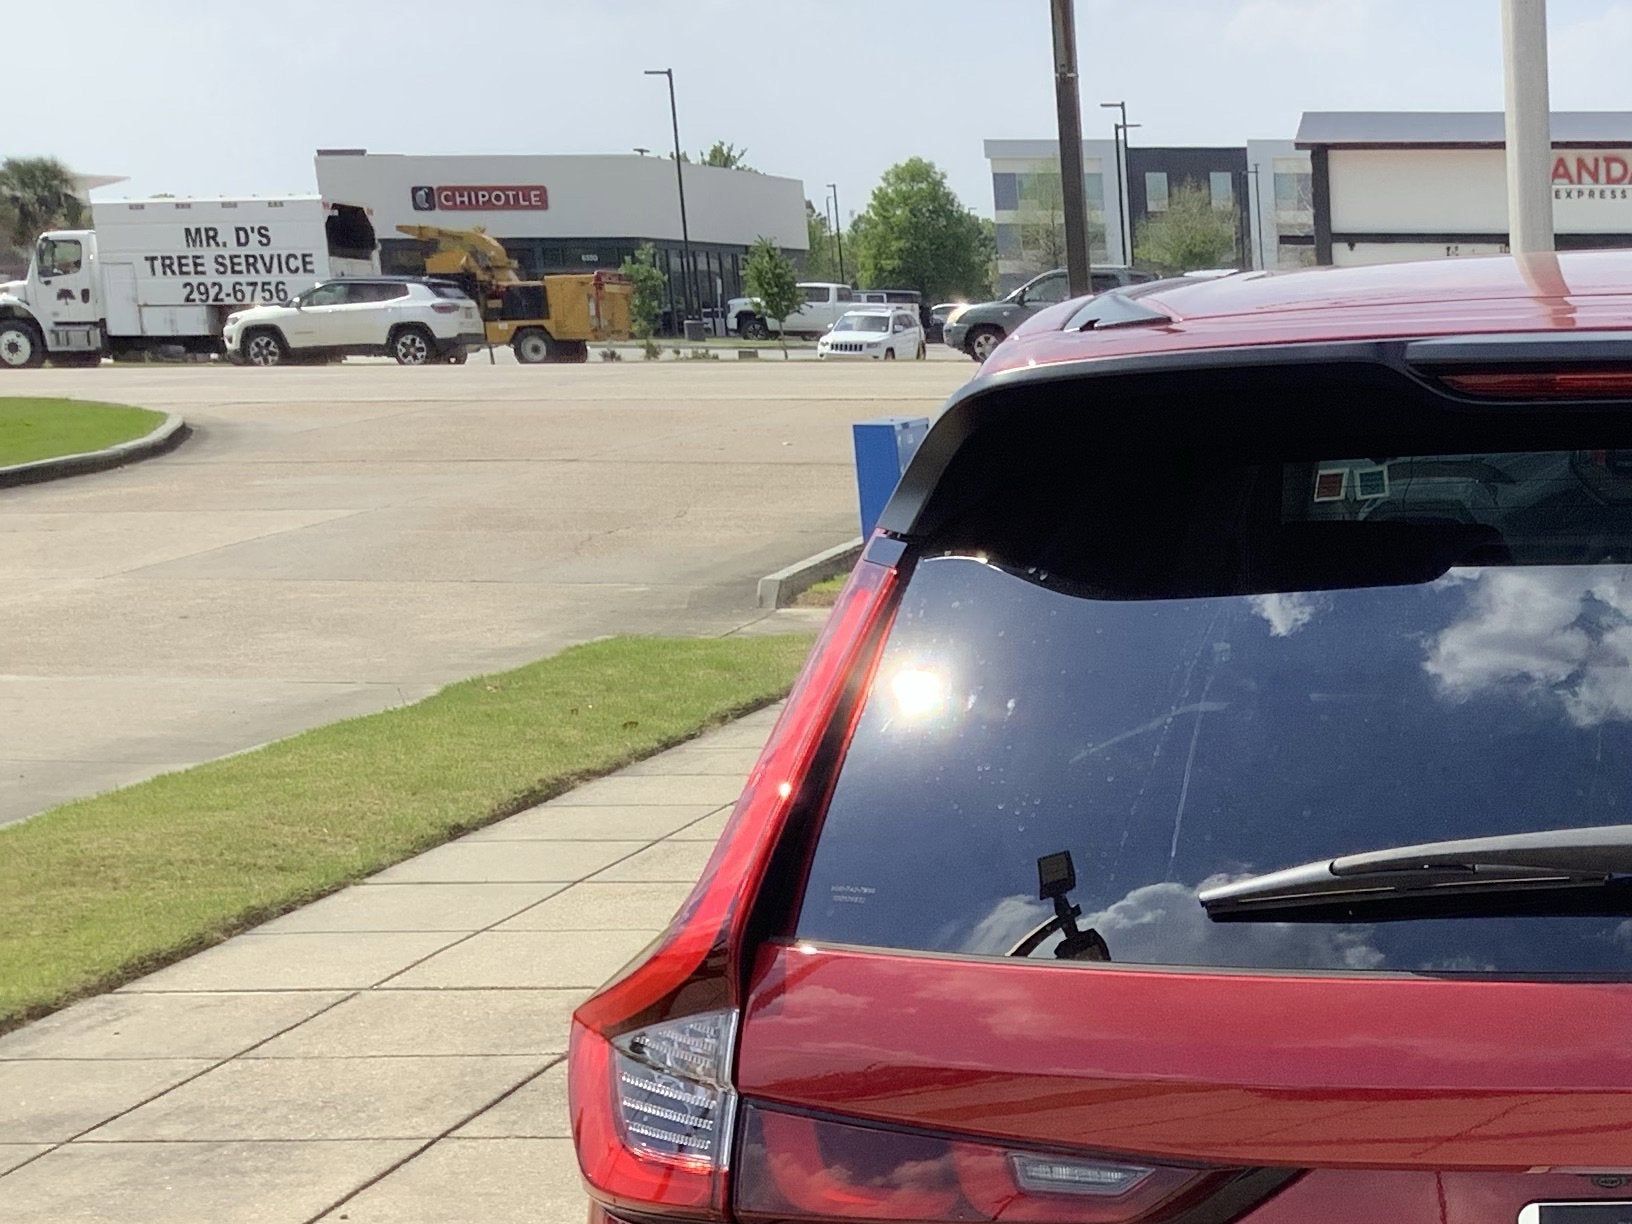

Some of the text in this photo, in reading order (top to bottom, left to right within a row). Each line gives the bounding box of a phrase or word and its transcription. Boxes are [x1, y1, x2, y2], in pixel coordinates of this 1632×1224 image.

[441, 190, 542, 207] CHIPOTLE
[1554, 189, 1628, 200] EXPRESS
[184, 225, 271, 248] MR. D'S
[144, 253, 315, 276] TREE SERVICE
[182, 280, 289, 303] 292-6756
